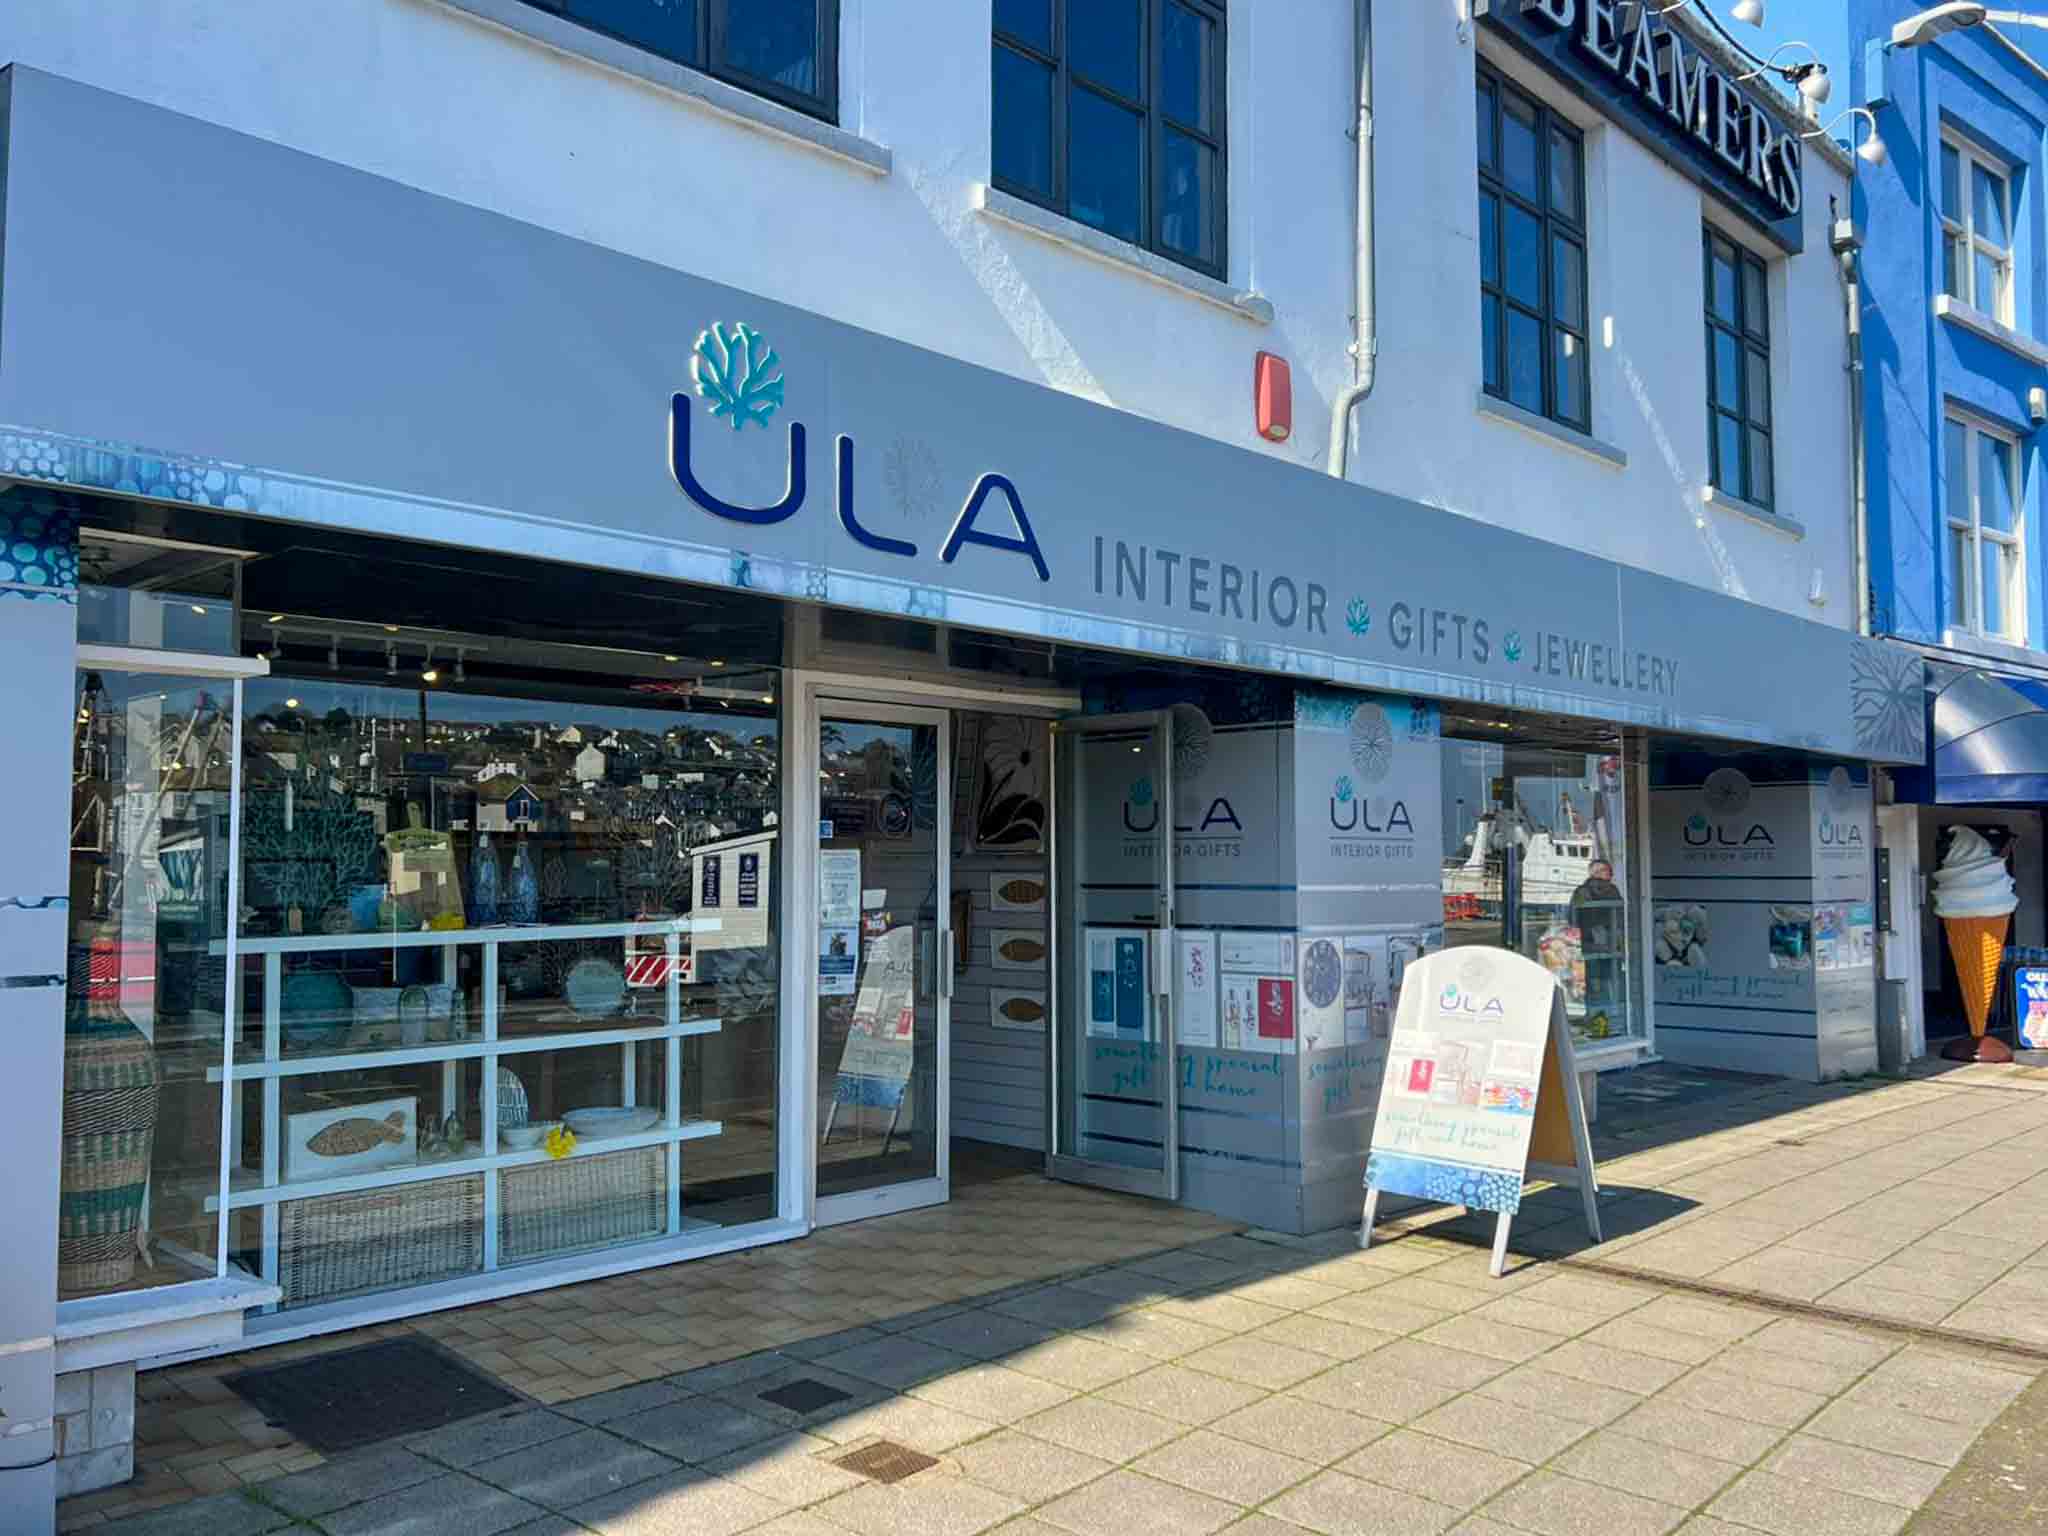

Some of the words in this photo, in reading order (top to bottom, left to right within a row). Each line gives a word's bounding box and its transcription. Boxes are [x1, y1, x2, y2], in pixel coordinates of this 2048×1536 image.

[1520, 0, 1800, 215] EAMERS
[668, 392, 1050, 582] ULA
[1094, 535, 1328, 635] INTERIOR
[1388, 602, 1490, 665] GIFTS
[1532, 631, 1679, 698] JEWELLERY
[1330, 797, 1413, 833] ULA
[1683, 824, 1775, 846] ULA
[1818, 824, 1863, 845] ULA
[1199, 843, 1241, 858] GIFTS
[1330, 844, 1381, 859] INTERIOR
[1384, 845, 1414, 859] GIFTS
[1440, 994, 1505, 1015] ULA
